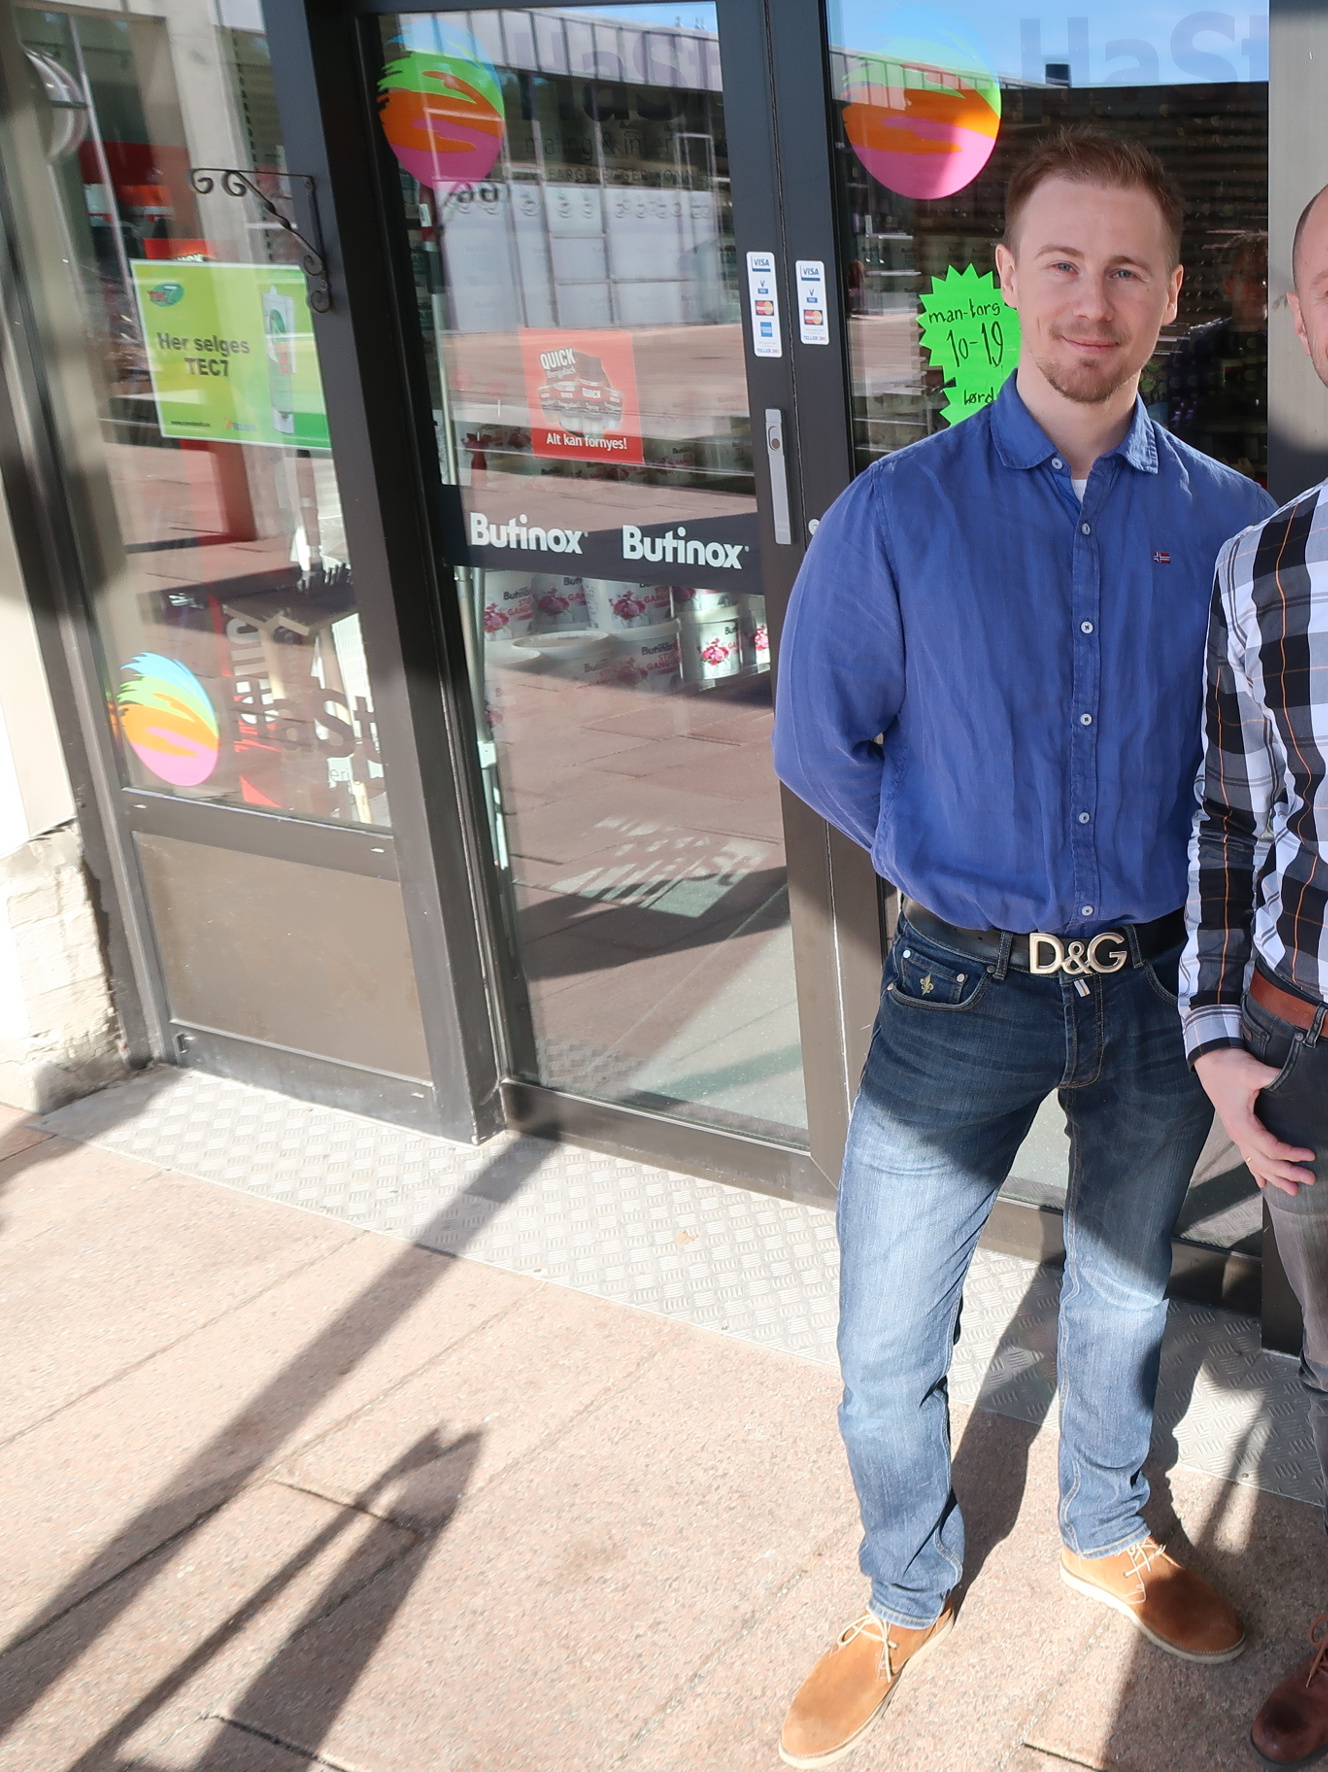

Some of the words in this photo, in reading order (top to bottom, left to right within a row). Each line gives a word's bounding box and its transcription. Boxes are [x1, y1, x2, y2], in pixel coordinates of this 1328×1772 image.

[753, 258, 770, 267] VISA
[803, 267, 820, 276] VISA
[928, 298, 1001, 324] man-tors
[156, 332, 188, 350] Her
[193, 334, 250, 357] selges
[946, 320, 1004, 368] 10-19
[184, 357, 230, 377] TEC7
[540, 348, 577, 371] QUICK
[546, 432, 562, 446] Alt
[563, 434, 583, 447] kan
[584, 434, 628, 452] fornyes!
[469, 512, 584, 555] Butinox
[622, 524, 743, 570] Butinox
[1028, 931, 1128, 975] D&G
